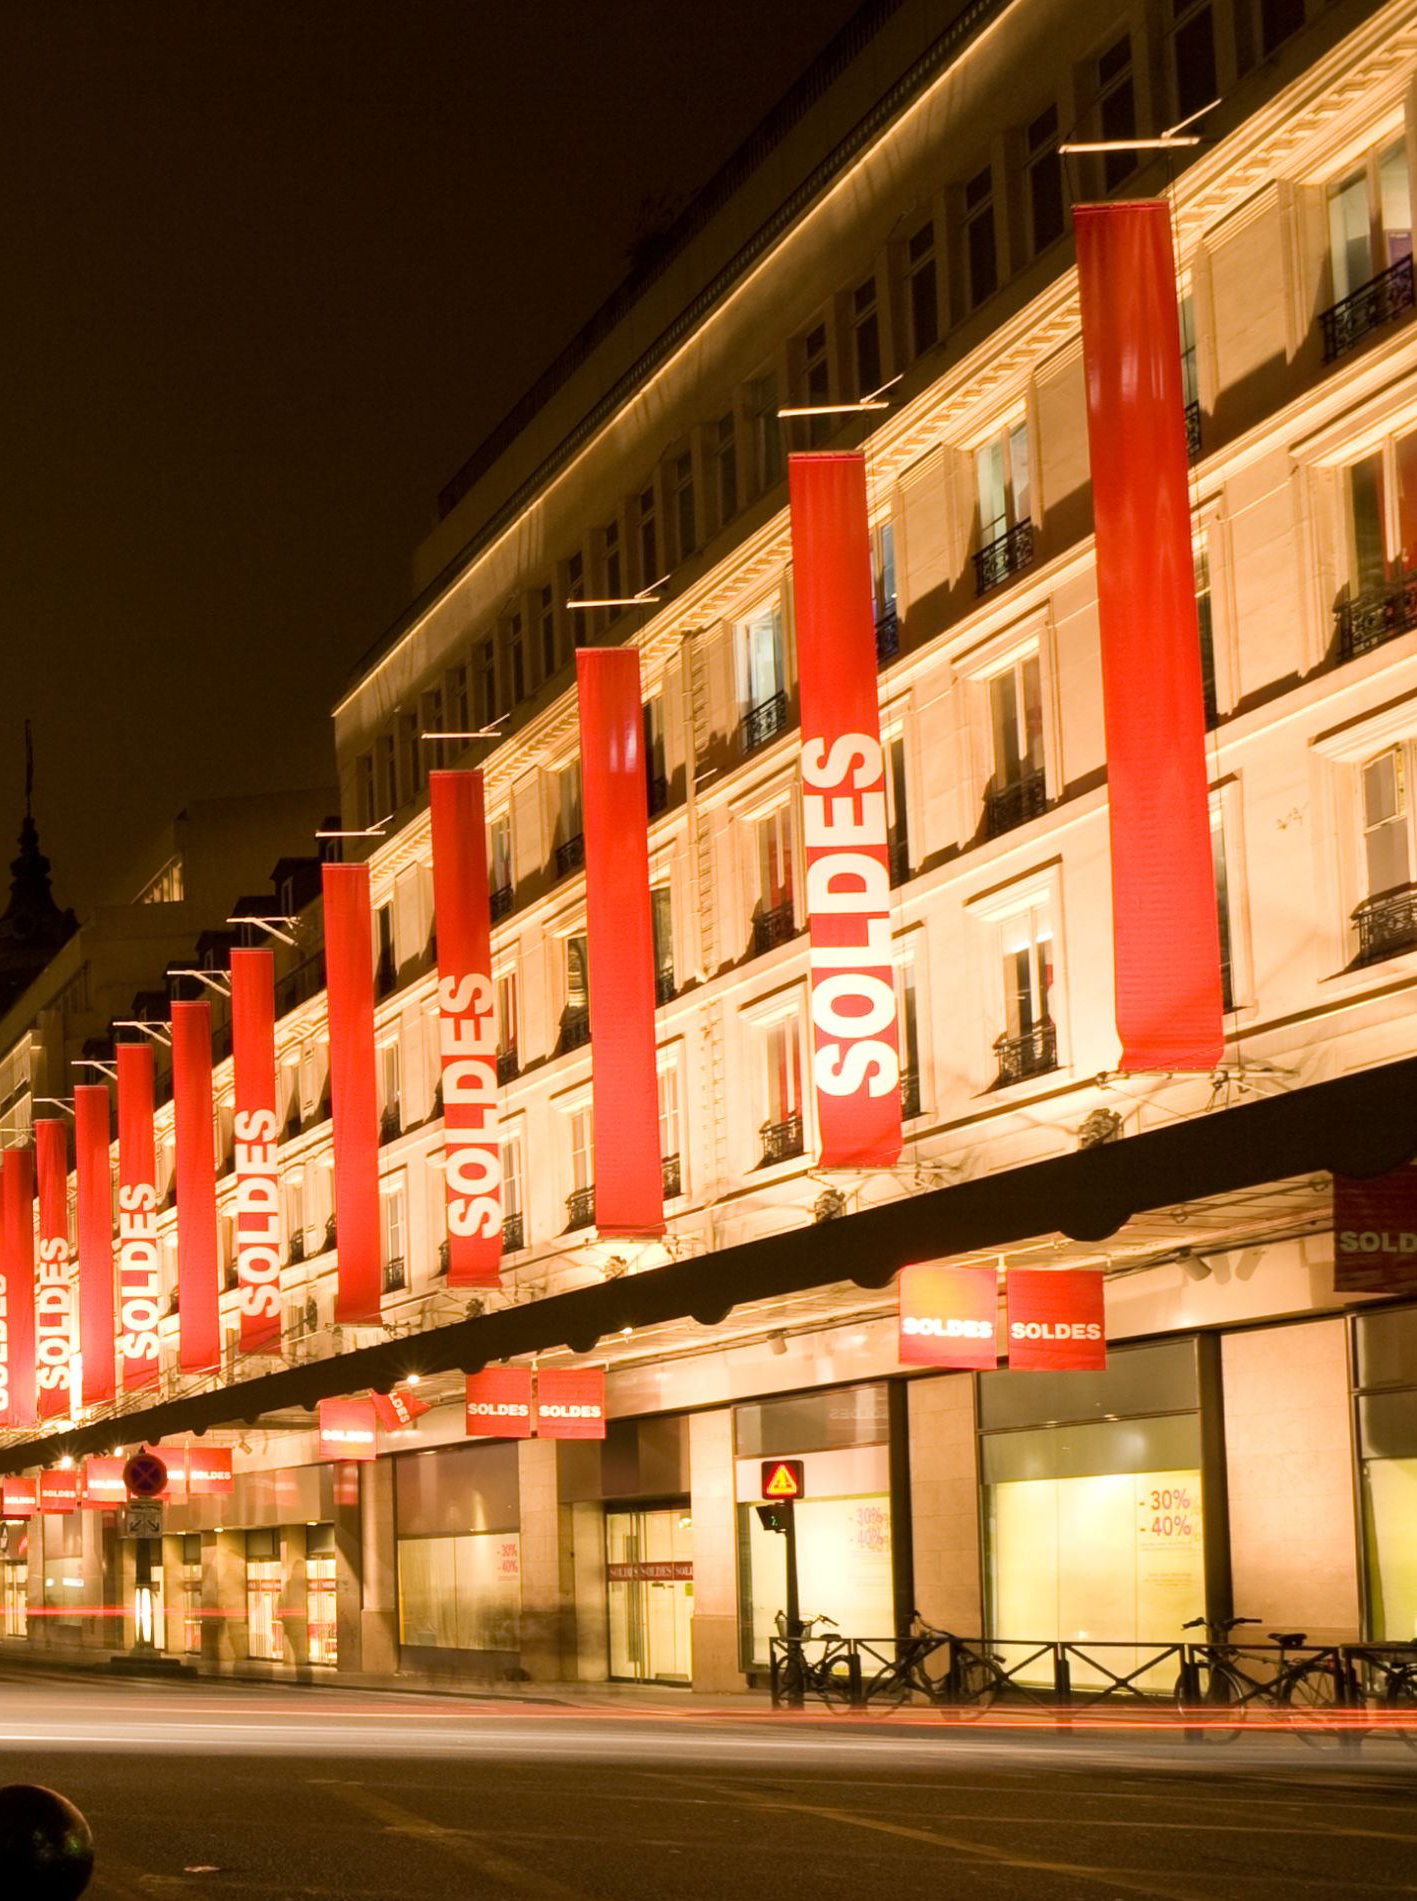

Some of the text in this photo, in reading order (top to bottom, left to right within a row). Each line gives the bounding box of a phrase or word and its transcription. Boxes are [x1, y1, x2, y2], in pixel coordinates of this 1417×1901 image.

[801, 733, 898, 1098] SOLDES
[438, 973, 502, 1239] SOLDES
[234, 1108, 281, 1318] SOLDES
[119, 1183, 159, 1361] SOLDES
[37, 1237, 72, 1390] SOLDES
[902, 1317, 993, 1339] SOLDES
[1010, 1322, 1102, 1340] SOLDES
[468, 1403, 529, 1417] SOLDES
[538, 1404, 601, 1418] SOLDES
[321, 1428, 374, 1443] SOLDES
[190, 1471, 231, 1480] SOLDES
[42, 1490, 76, 1498] SOLDES
[1151, 1489, 1191, 1511] 30%
[1152, 1515, 1192, 1537] 40%
